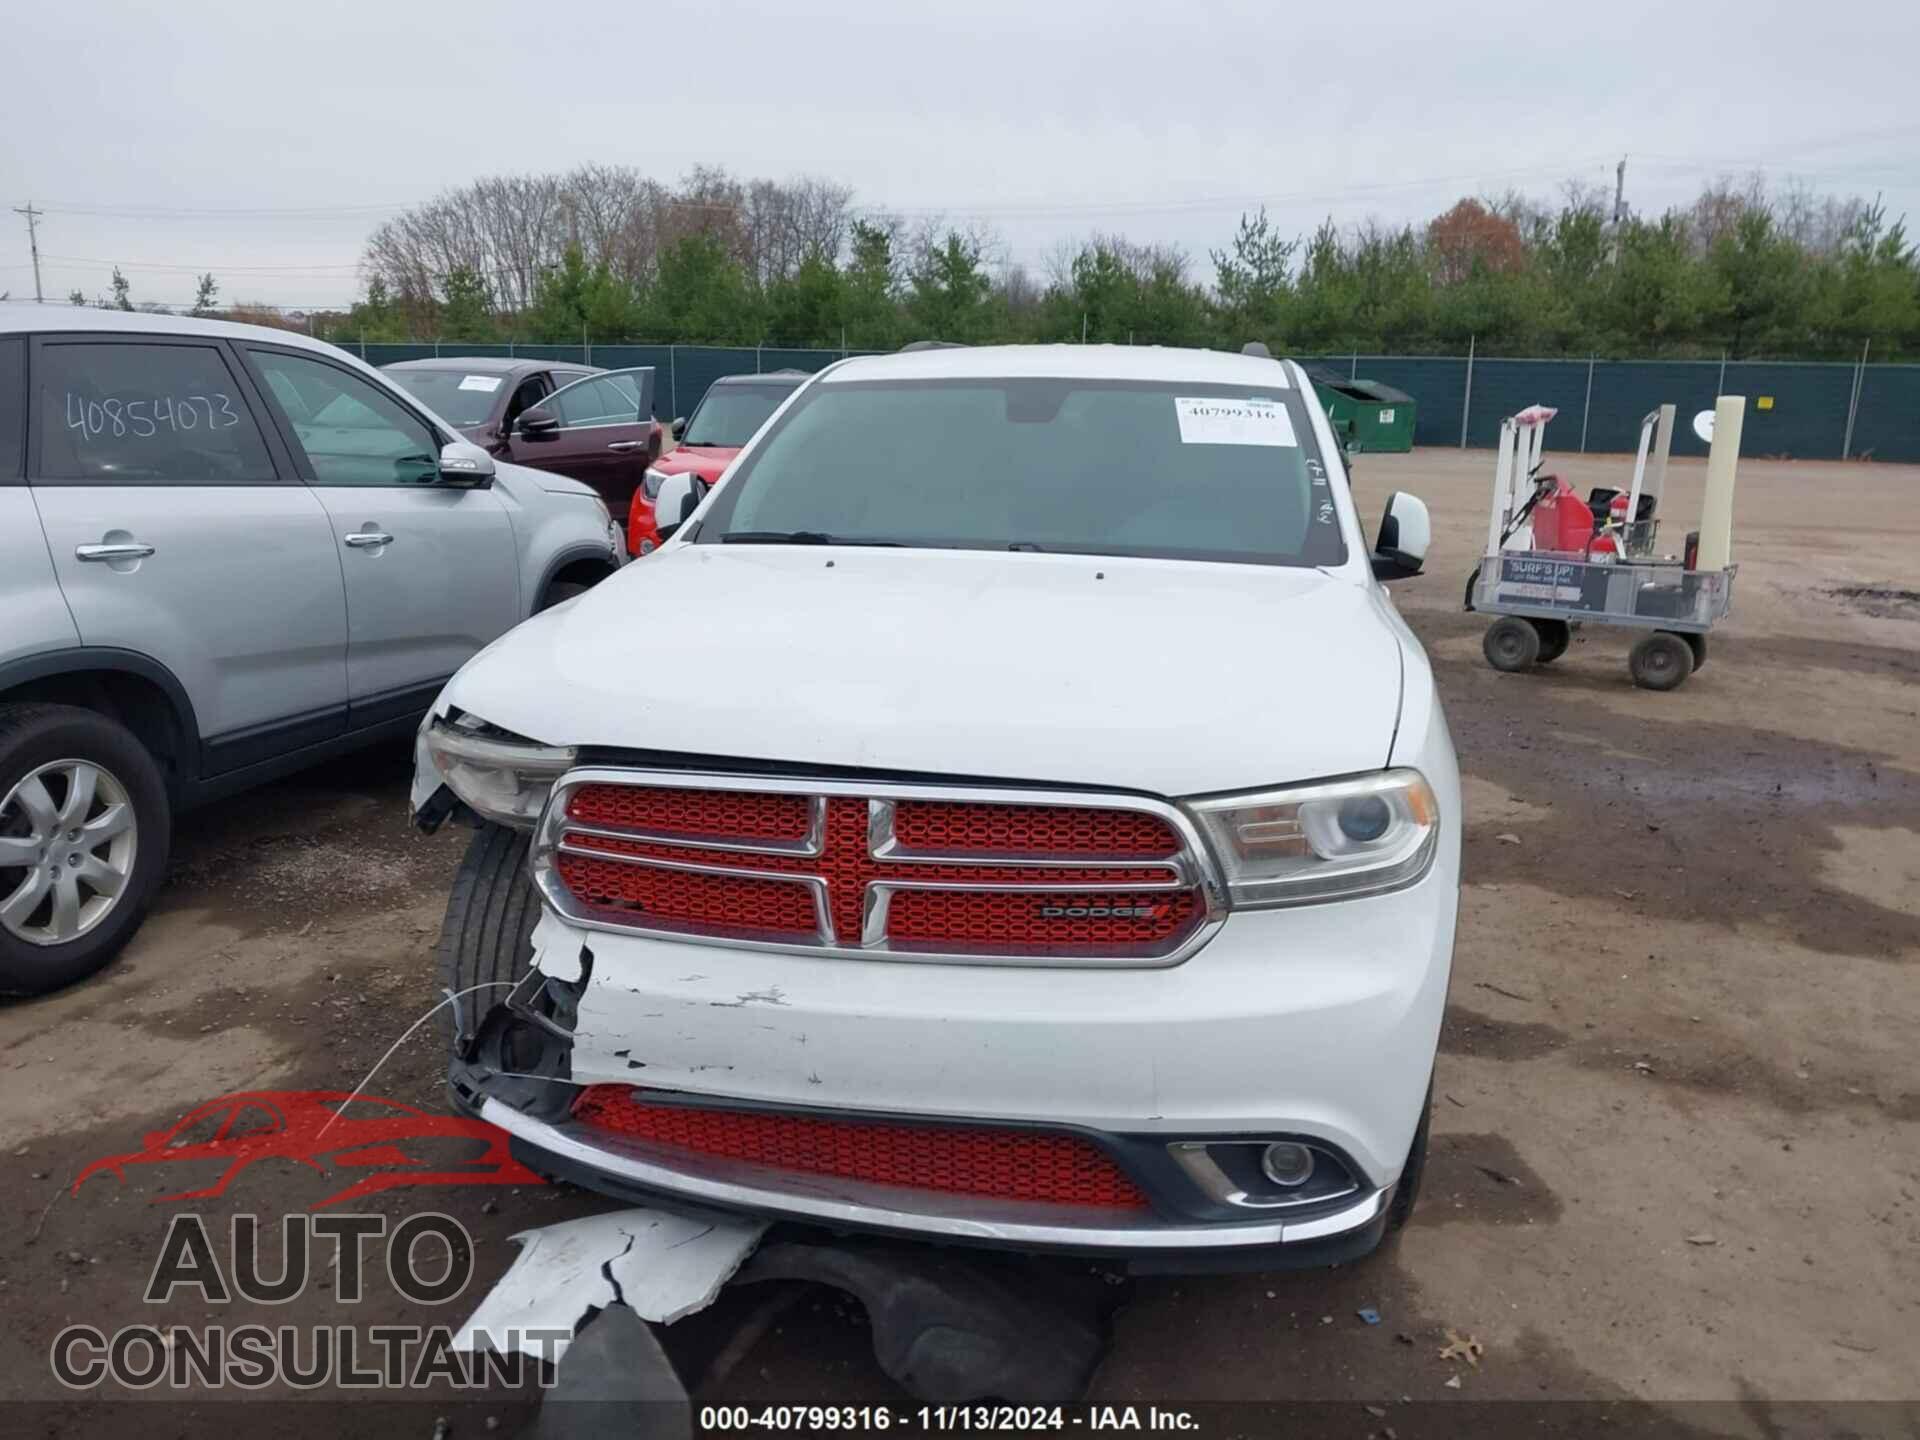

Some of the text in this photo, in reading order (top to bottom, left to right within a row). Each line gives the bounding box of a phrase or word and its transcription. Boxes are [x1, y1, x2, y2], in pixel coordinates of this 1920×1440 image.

[66, 392, 239, 440] 40854073
[1189, 407, 1276, 419] 40799316
[1042, 907, 1153, 917] DODGE
